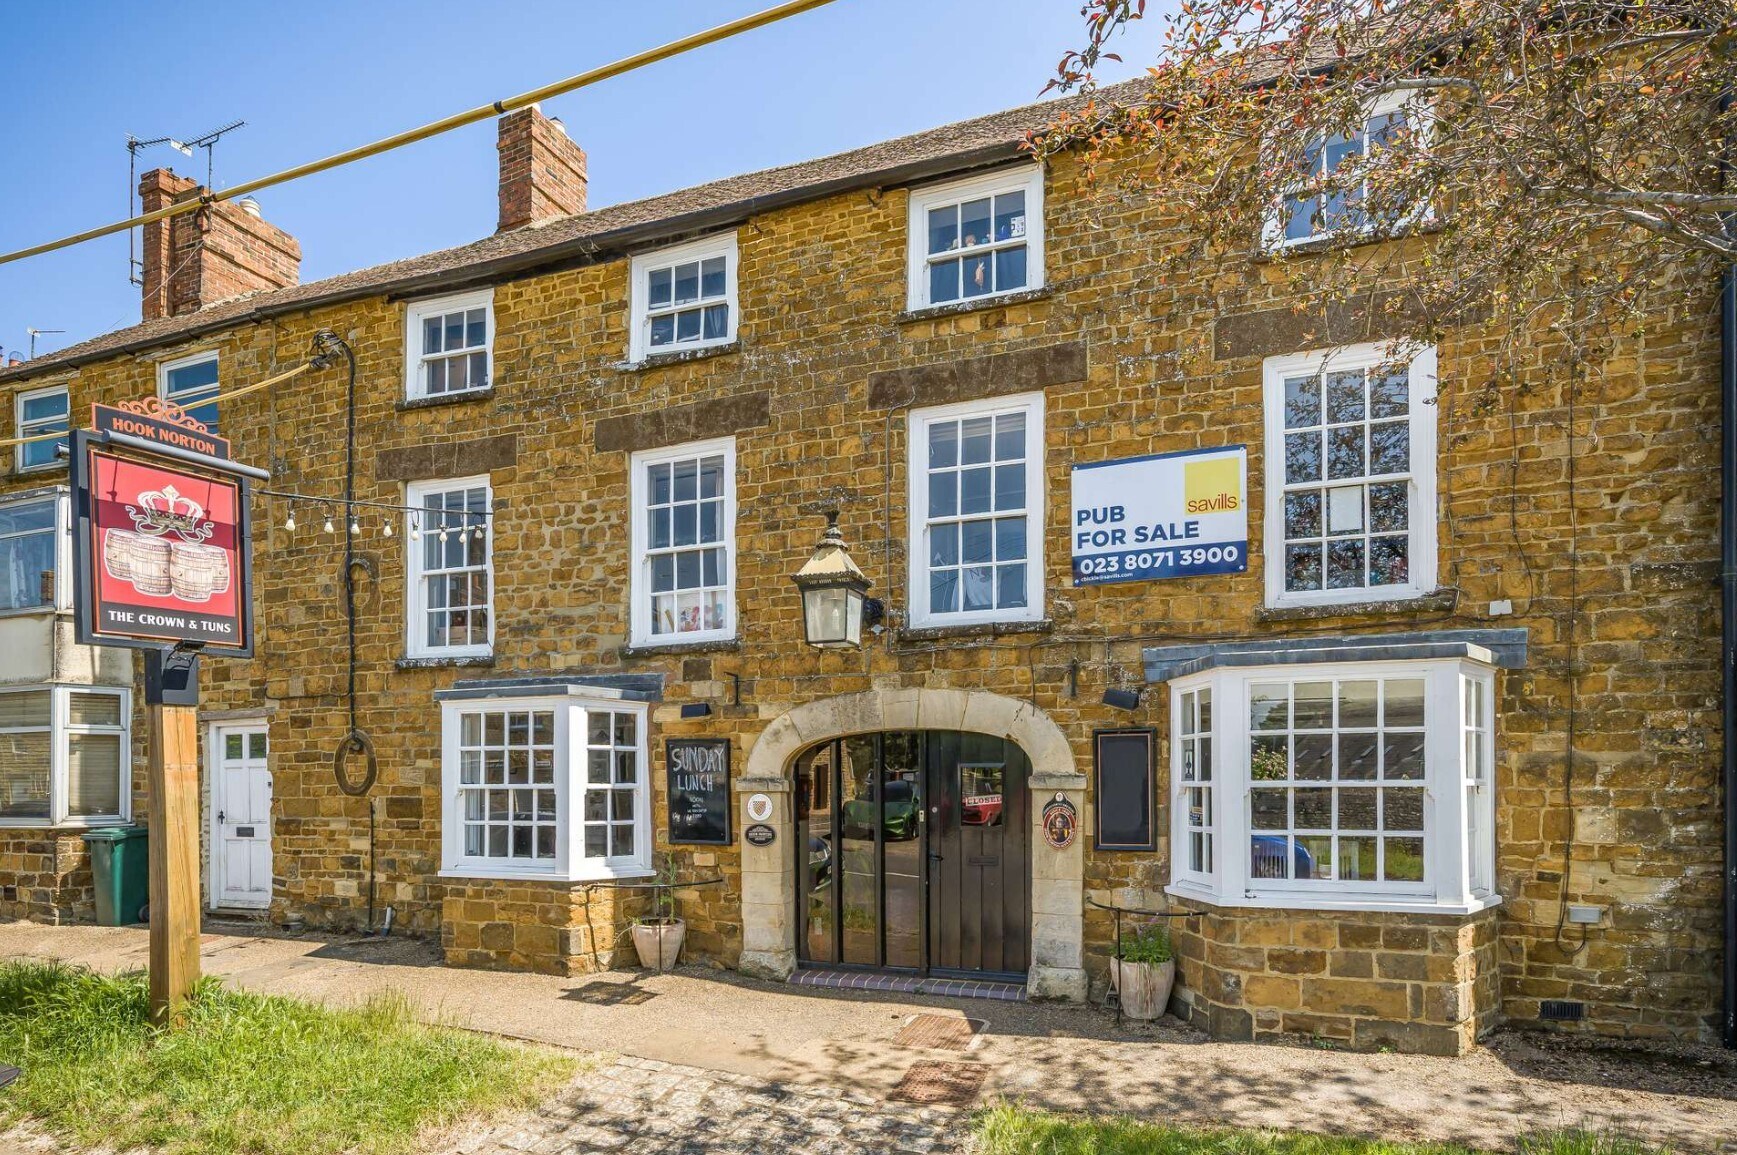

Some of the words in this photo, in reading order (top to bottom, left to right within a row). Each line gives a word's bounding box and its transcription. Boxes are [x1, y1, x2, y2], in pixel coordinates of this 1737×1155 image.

[112, 417, 156, 439] HOOK
[159, 428, 216, 456] NORTON
[1077, 505, 1126, 527] PUB
[1187, 493, 1238, 513] savills
[1077, 528, 1127, 550] FOR
[1134, 520, 1200, 544] SALE
[1080, 556, 1119, 575] 023
[1124, 550, 1174, 571] 8071
[1179, 545, 1239, 567] 3900
[108, 609, 135, 624] THE
[138, 613, 185, 629] CROWN
[188, 619, 198, 630] &
[200, 620, 232, 634] TUNS
[671, 746, 725, 773] SUNDAY
[677, 774, 713, 792] LUNCH
